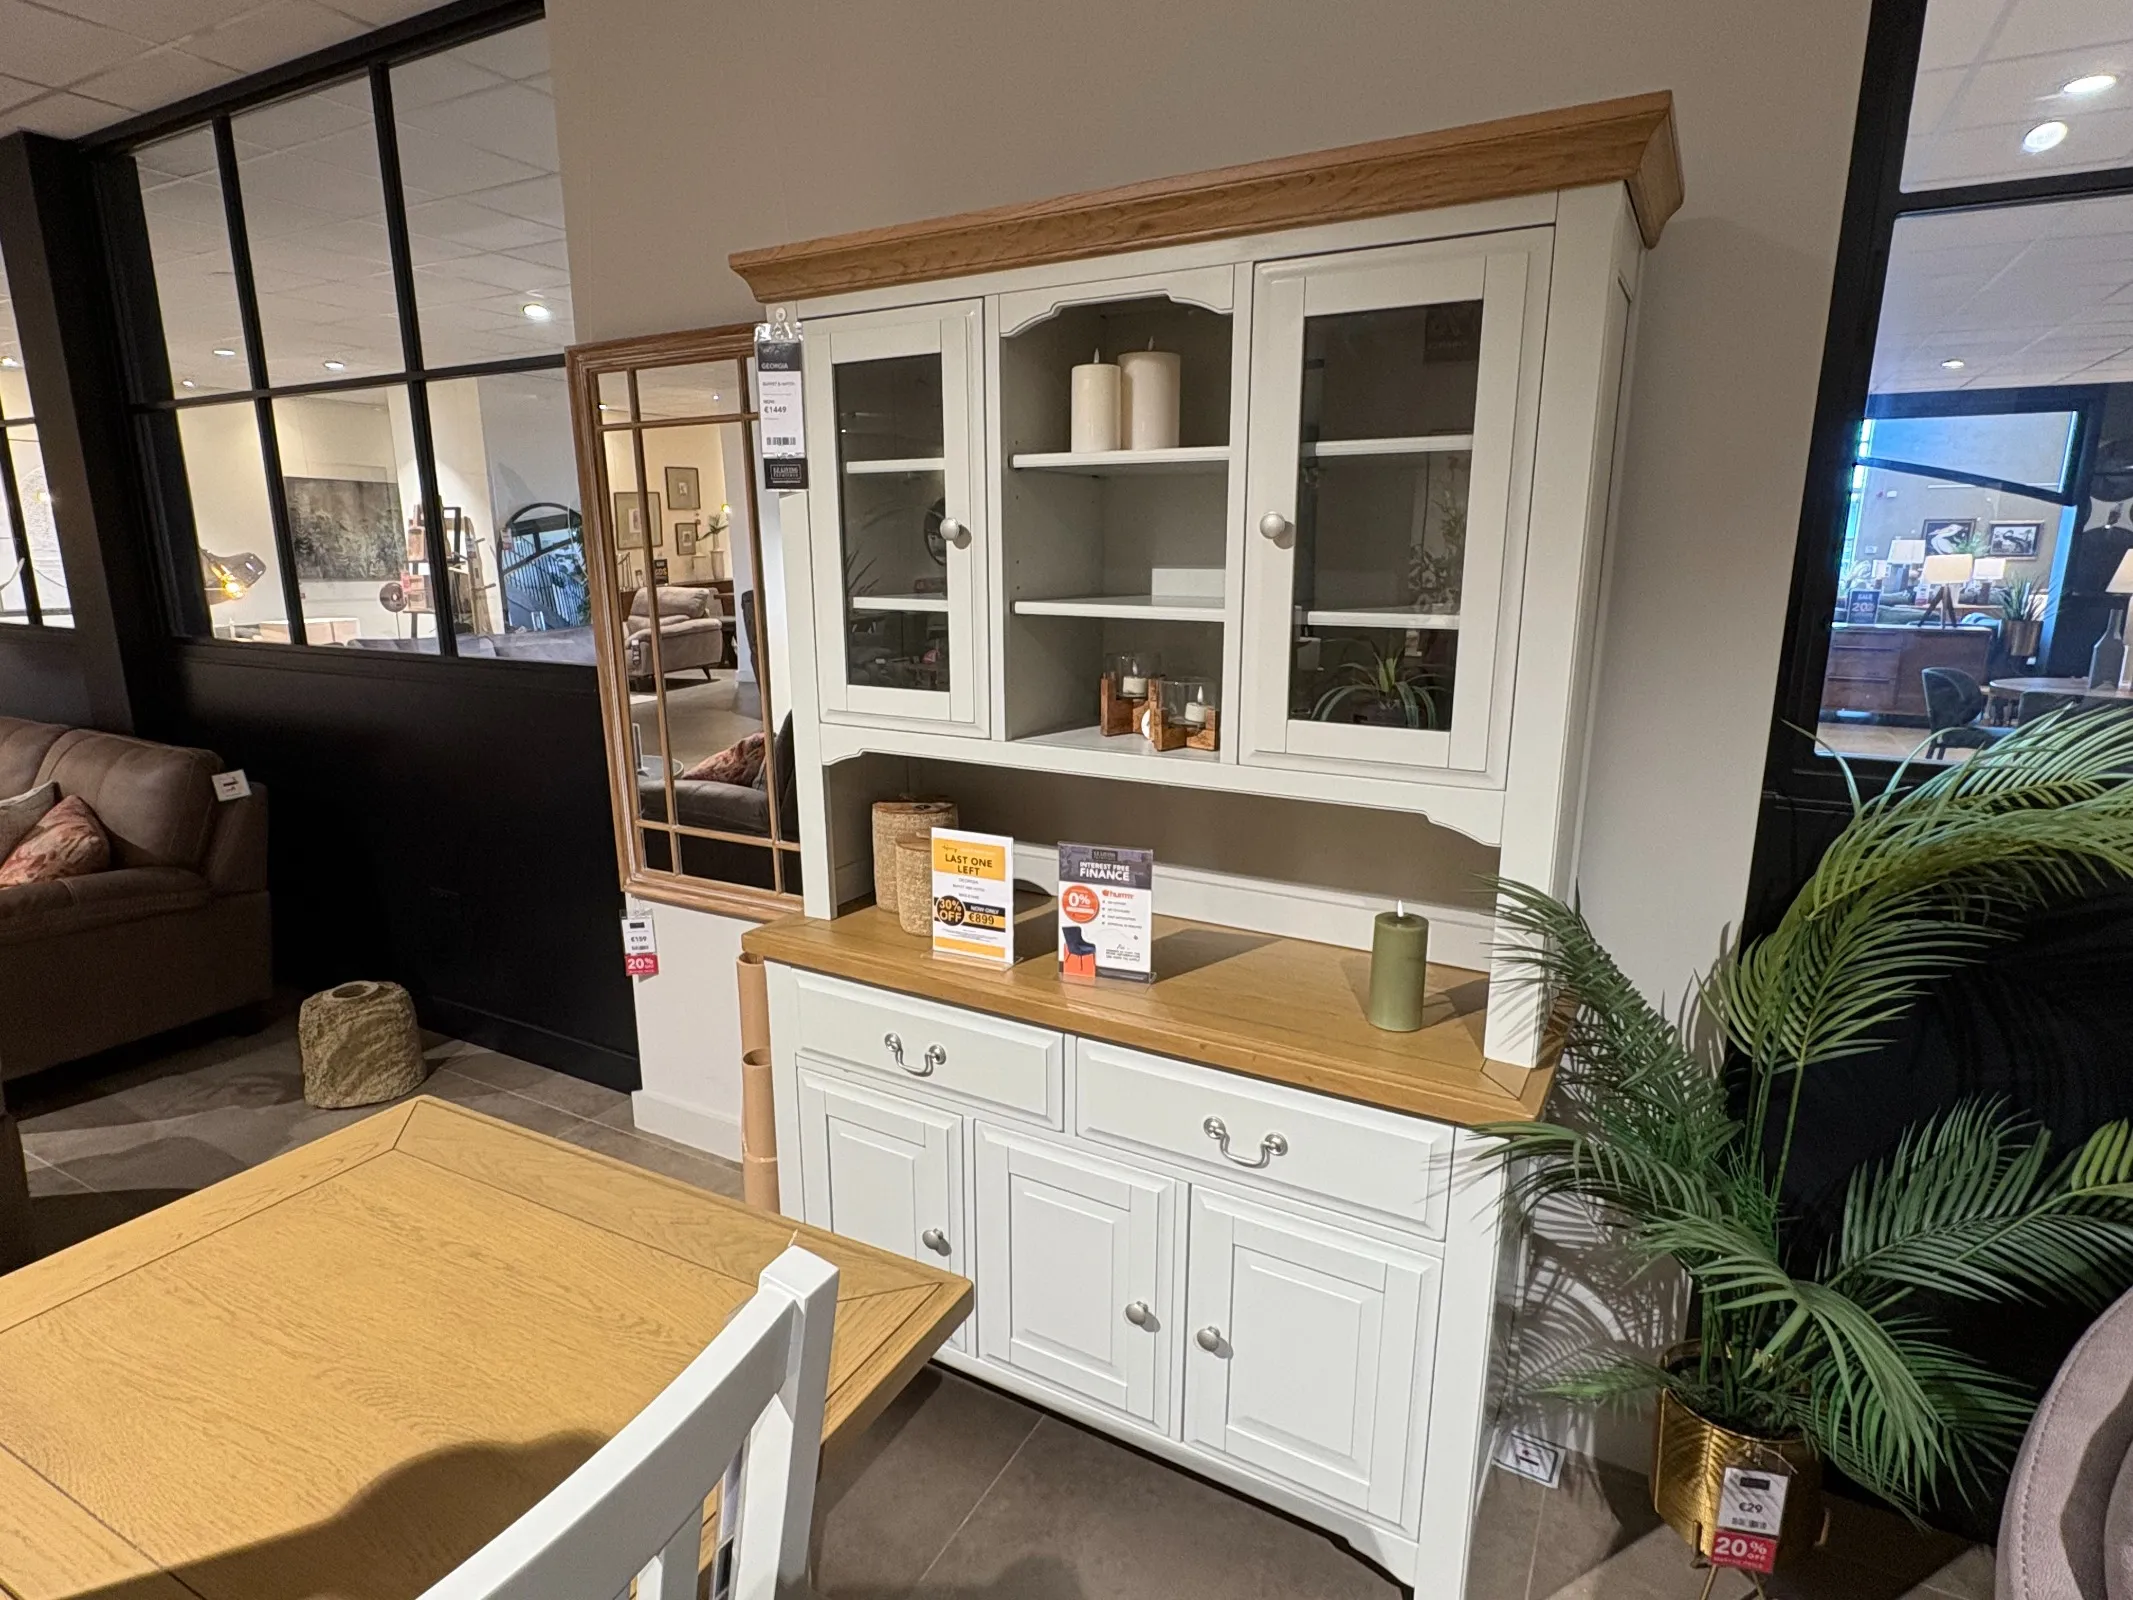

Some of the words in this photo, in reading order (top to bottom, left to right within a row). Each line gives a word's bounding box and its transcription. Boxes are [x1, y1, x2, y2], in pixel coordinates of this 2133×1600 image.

[761, 362, 789, 370] GEORGIA
[764, 406, 787, 414] €1449
[945, 854, 968, 865] LAST
[970, 857, 993, 868] ONE
[1079, 861, 1112, 870] INTEREST
[1112, 864, 1130, 872] FREE
[957, 865, 980, 876] LEFT
[1079, 868, 1130, 881] FINANCE
[939, 898, 962, 912] 30%
[1068, 891, 1091, 907] 0%
[939, 910, 962, 922] OFF
[968, 912, 995, 925] €899
[627, 957, 655, 970] 20%
[1738, 1501, 1763, 1513] €29
[1714, 1536, 1768, 1557] 20%
